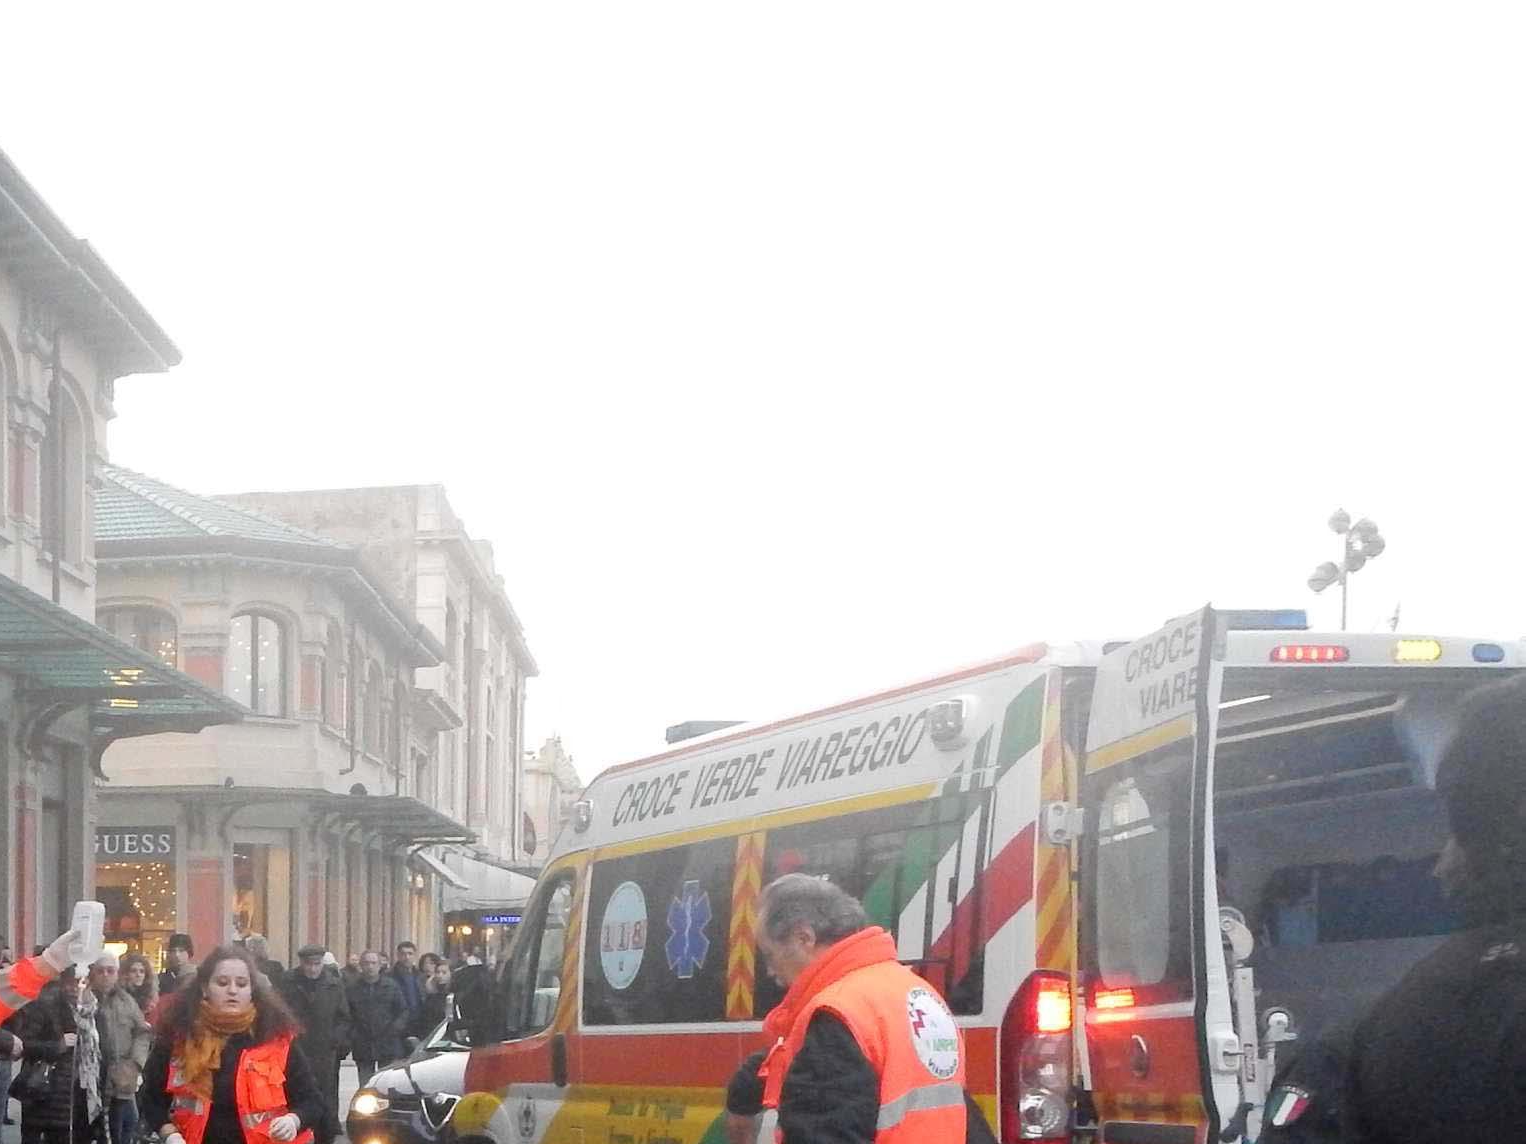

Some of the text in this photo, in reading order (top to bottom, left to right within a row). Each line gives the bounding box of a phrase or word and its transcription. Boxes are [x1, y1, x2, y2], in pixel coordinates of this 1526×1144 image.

[1125, 621, 1195, 683] CROCE
[612, 708, 930, 827] CROCE VERDE VIAREGGIO
[601, 921, 643, 952] 118
